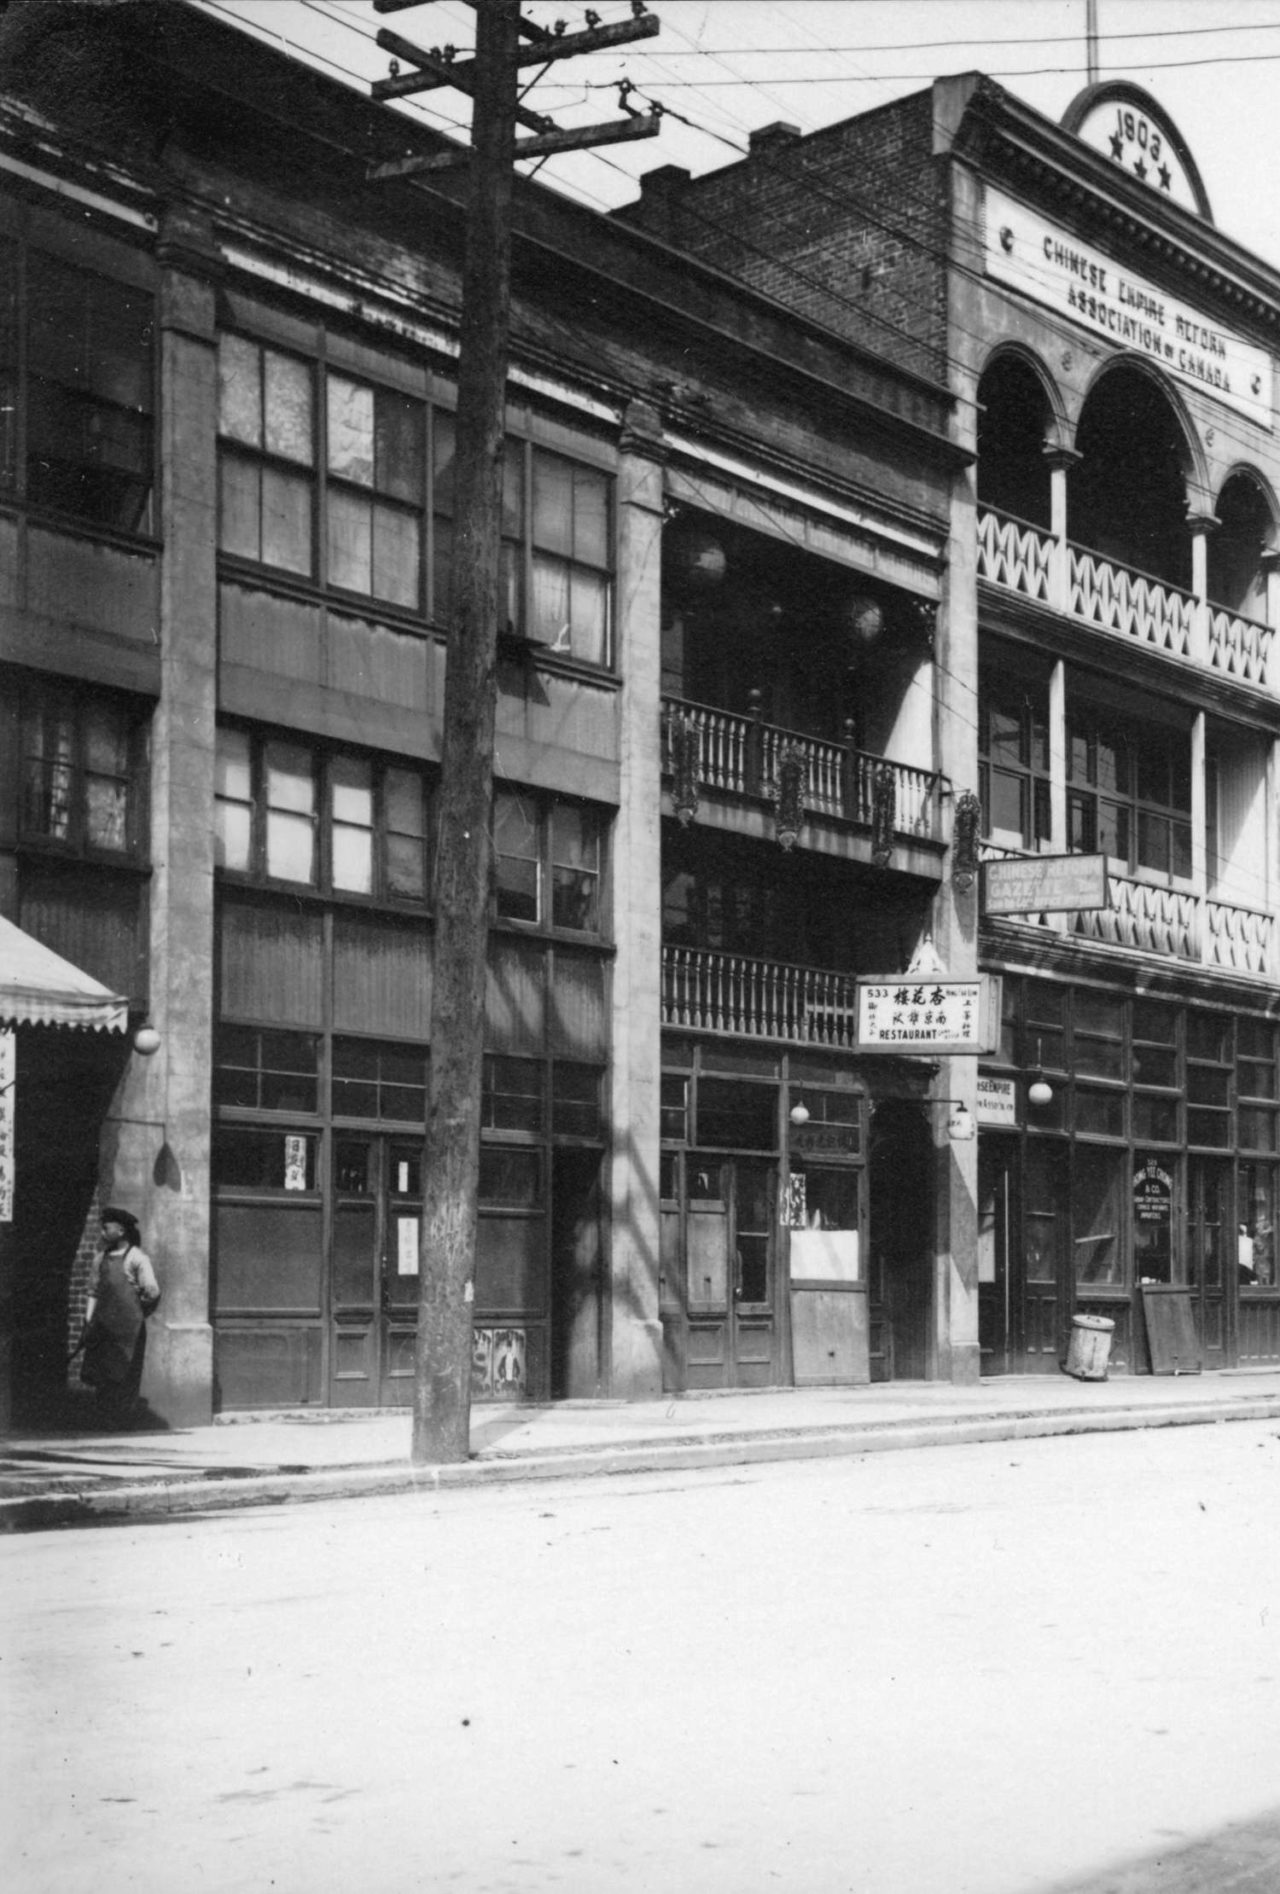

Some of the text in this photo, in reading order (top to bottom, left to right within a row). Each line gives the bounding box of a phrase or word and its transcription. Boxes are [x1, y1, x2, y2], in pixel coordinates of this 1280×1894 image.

[1044, 235, 1226, 361] CHINESE EMPIRE REFORM
[1068, 284, 1162, 355] ASSOCIATION
[1179, 348, 1231, 393] CANADA
[988, 861, 1043, 880] CHINESE
[867, 988, 888, 998] 533
[879, 1029, 937, 1040] RESTAURANT
